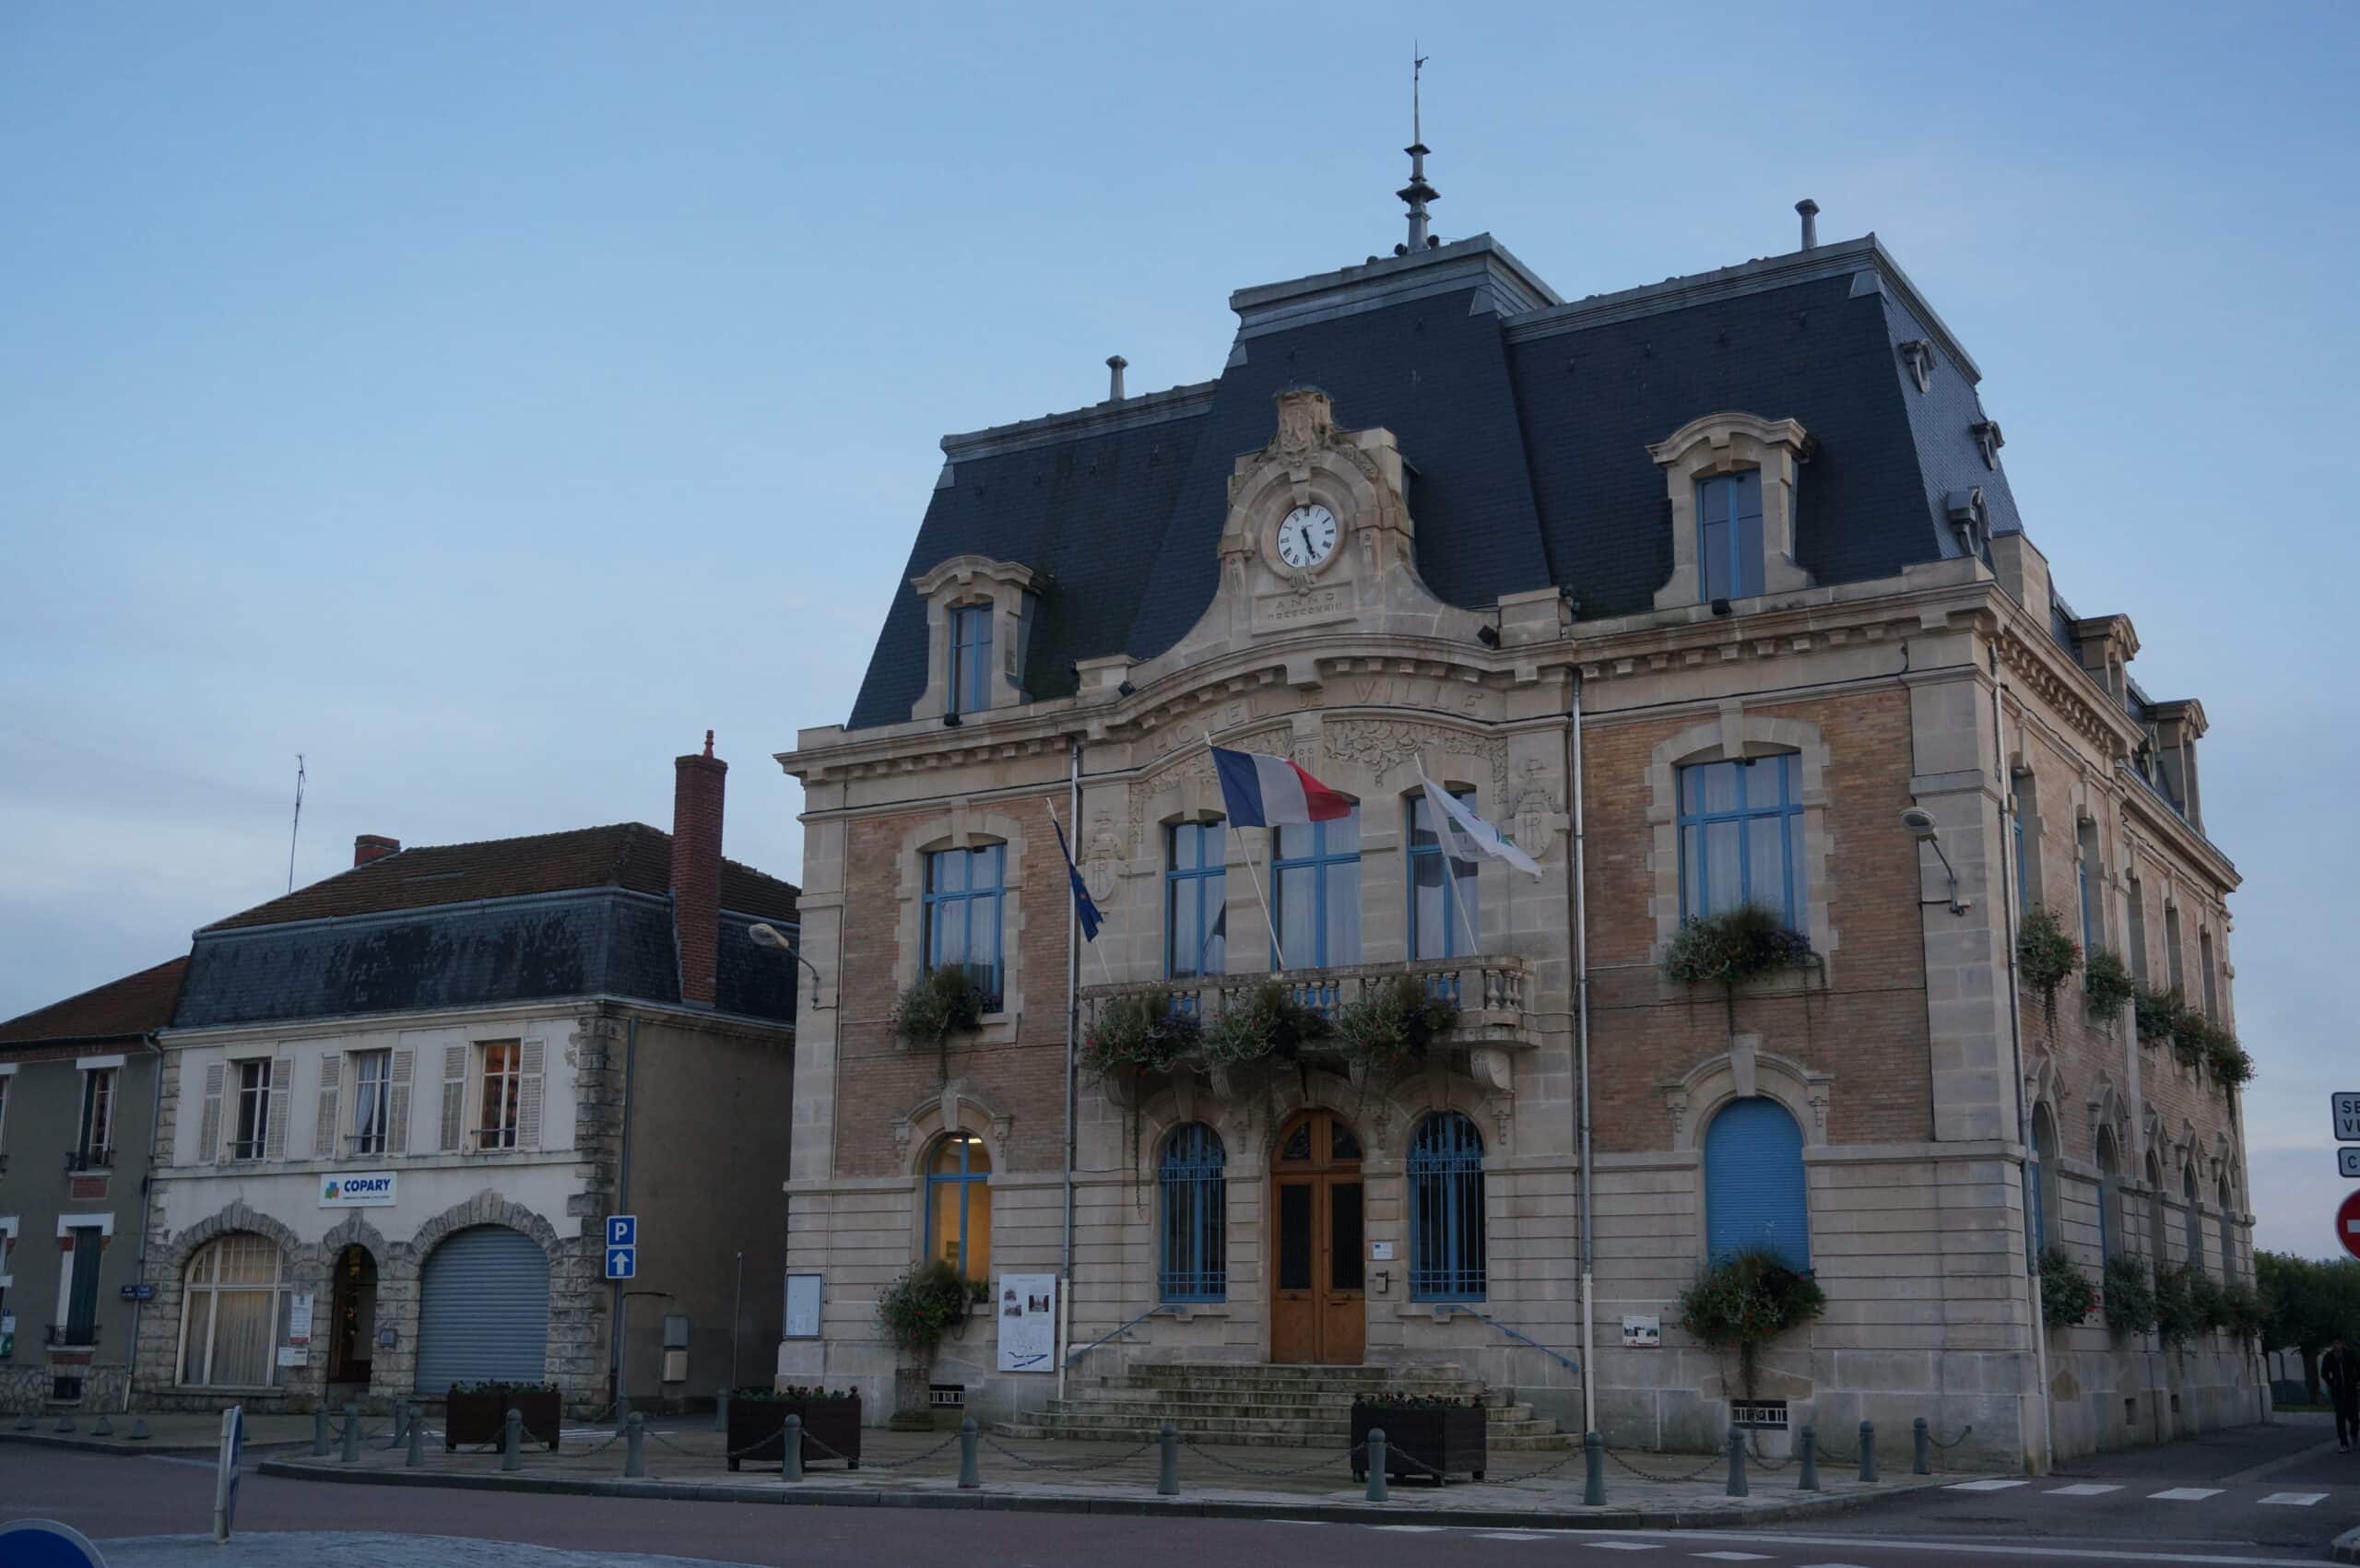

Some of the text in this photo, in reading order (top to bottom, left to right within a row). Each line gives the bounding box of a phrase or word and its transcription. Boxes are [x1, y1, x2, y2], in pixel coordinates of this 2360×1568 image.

[1276, 593, 1335, 608] ANNO
[1297, 692, 1322, 708] DE
[1354, 680, 1483, 715] VILLE
[344, 1178, 391, 1192] COPARY
[615, 1221, 628, 1242] P
